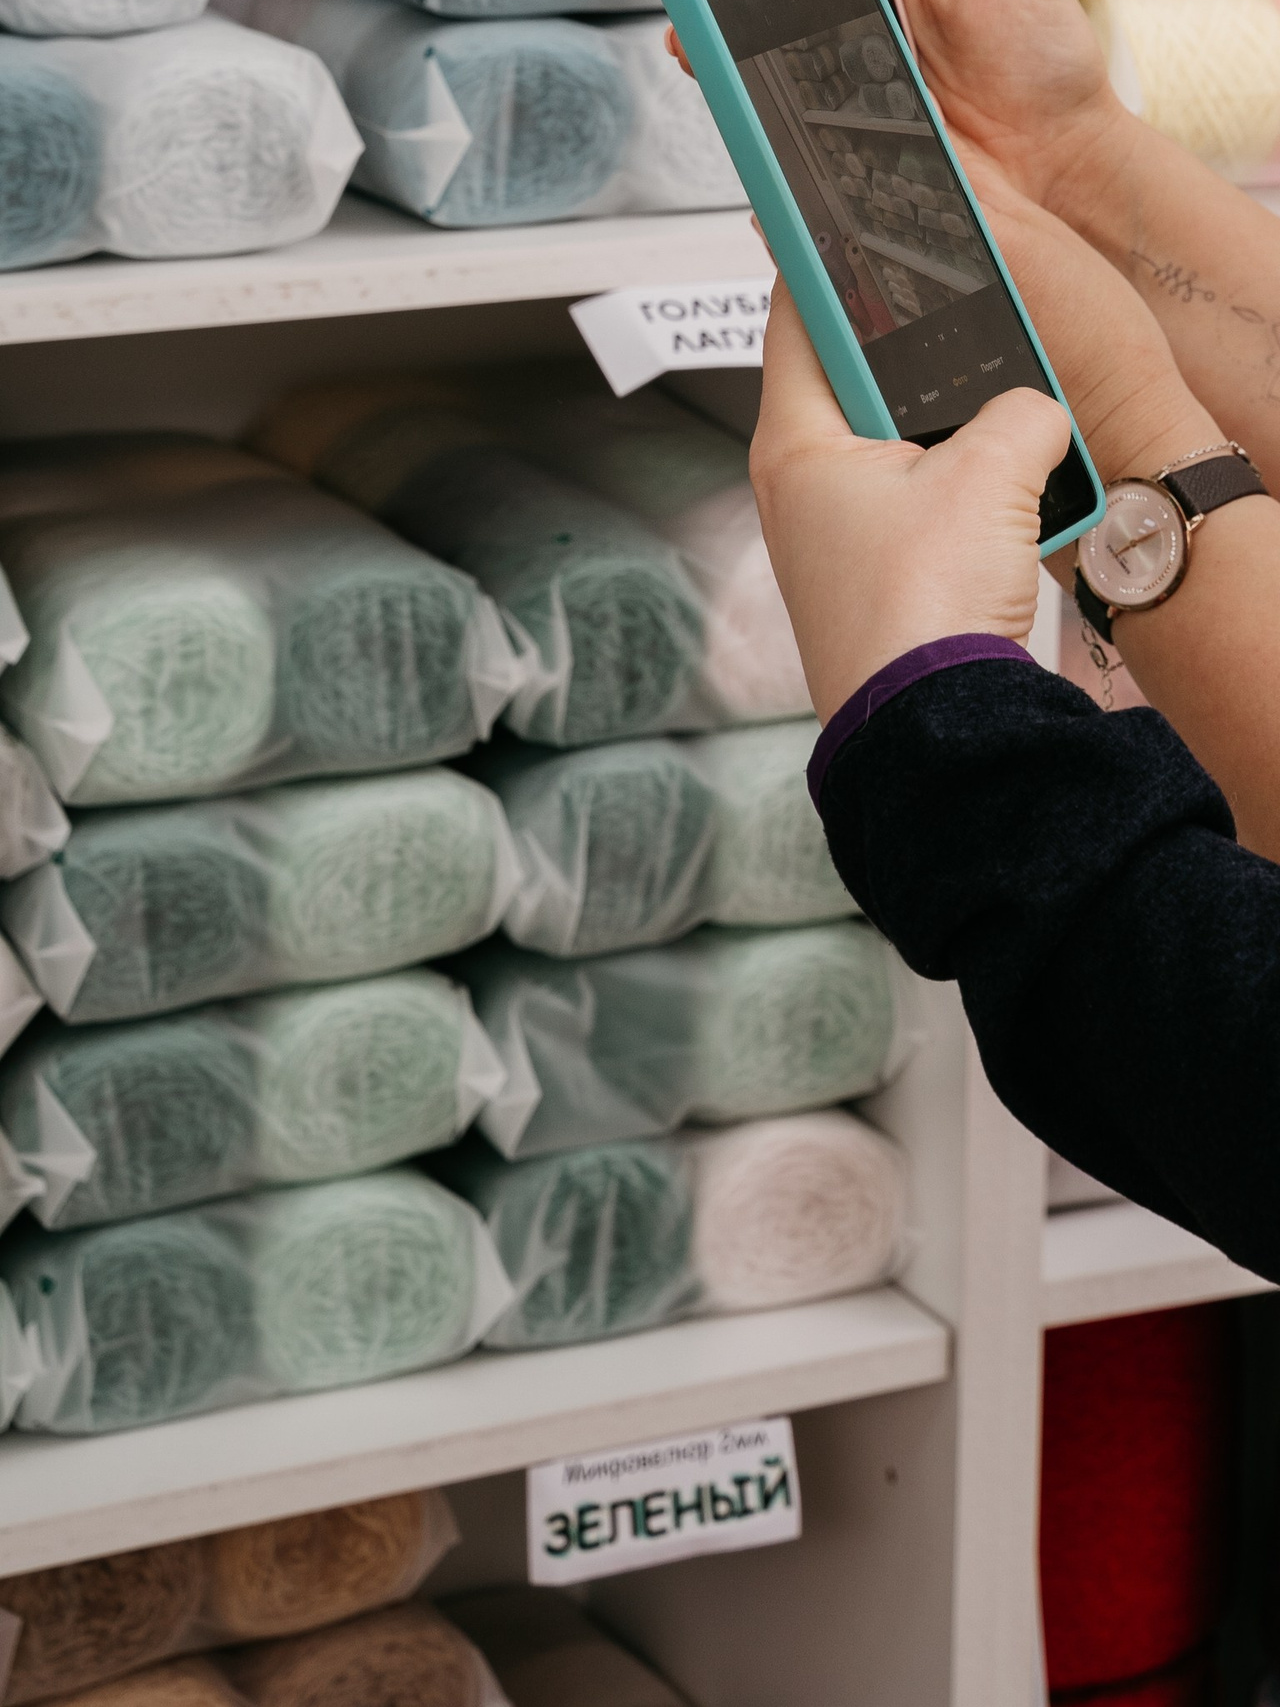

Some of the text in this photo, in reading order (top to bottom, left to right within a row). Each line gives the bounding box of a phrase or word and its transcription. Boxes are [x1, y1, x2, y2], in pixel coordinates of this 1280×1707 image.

[673, 327, 763, 354] ЛАГУ
[920, 389, 940, 404] Видео
[980, 356, 1004, 373] Портрет
[544, 1456, 791, 1557] ЗЕЛЕНЫЙ
